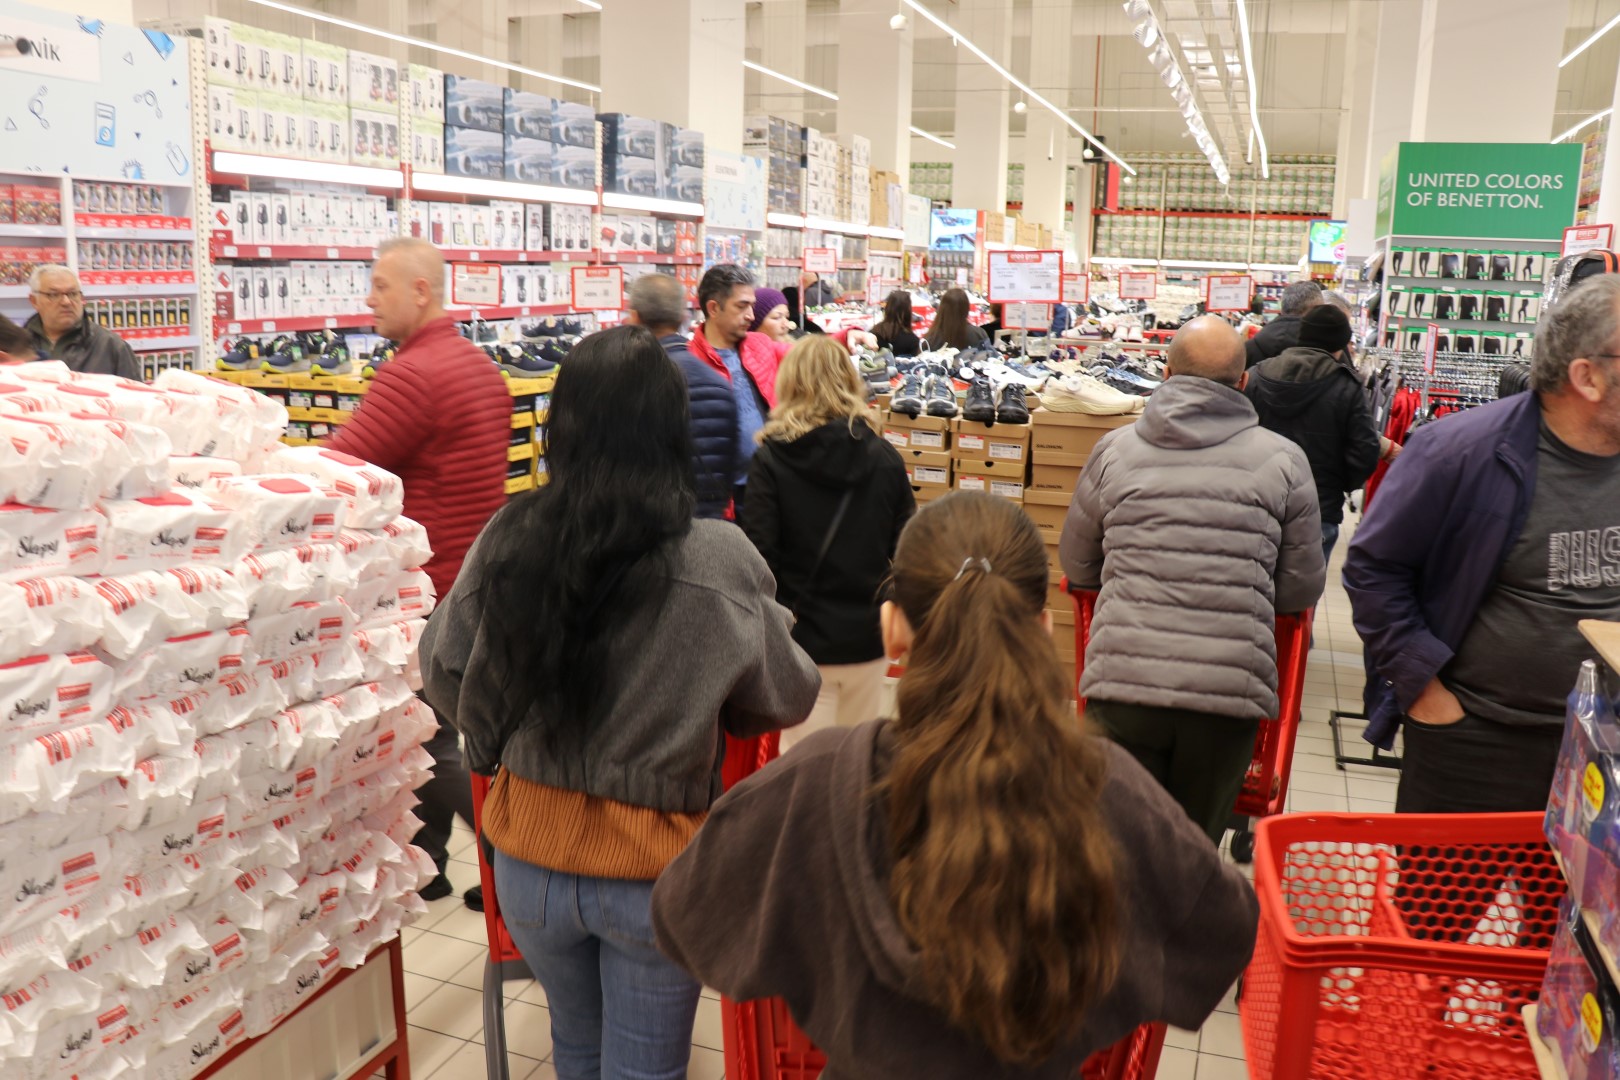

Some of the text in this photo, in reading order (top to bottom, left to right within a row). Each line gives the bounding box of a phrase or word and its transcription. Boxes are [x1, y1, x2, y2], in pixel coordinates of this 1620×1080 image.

[1408, 172, 1563, 190] UNITED COLORS
[1406, 191, 1544, 209] OF BENETTON.
